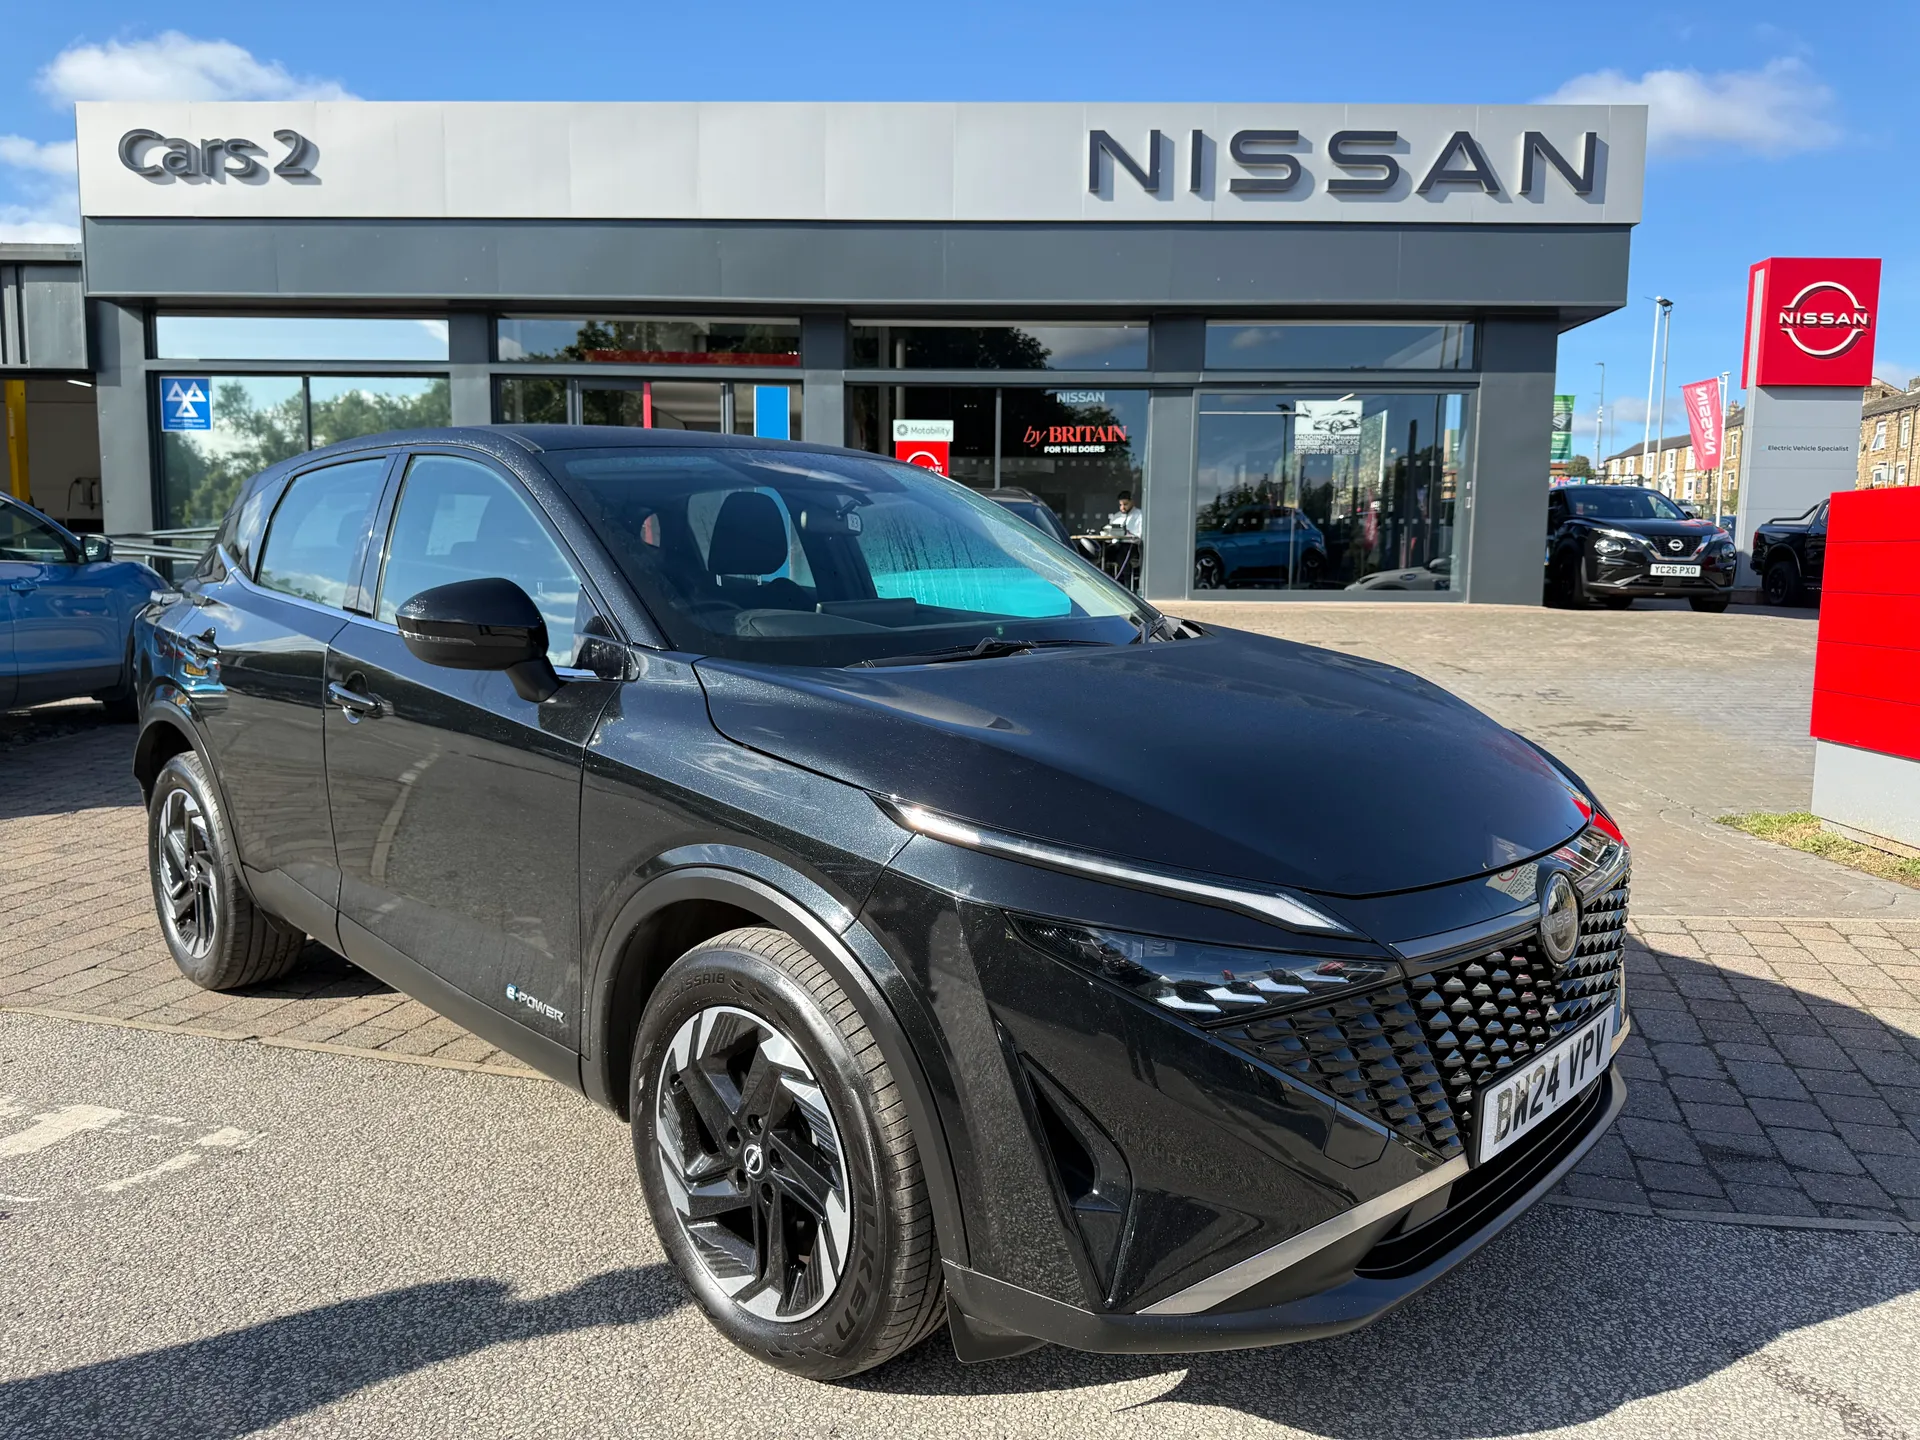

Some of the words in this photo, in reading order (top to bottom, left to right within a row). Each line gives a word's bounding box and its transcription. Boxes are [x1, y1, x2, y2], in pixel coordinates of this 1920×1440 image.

[118, 129, 254, 178] Cars
[273, 129, 309, 177] 2
[1088, 130, 1597, 196] NISSAN
[1779, 312, 1869, 326] NISSAN
[1056, 392, 1105, 403] NISSAN
[1023, 425, 1047, 448] by
[1048, 424, 1128, 443] BRITAIN
[1044, 445, 1061, 454] FOR
[1061, 445, 1078, 454] THE
[1078, 445, 1106, 454] DOERS
[1817, 445, 1849, 453] Specialist
[1654, 565, 1677, 574] YC26
[1679, 566, 1697, 575] PXO
[1494, 1053, 1560, 1145] BW24
[1569, 1017, 1608, 1089] VPV
